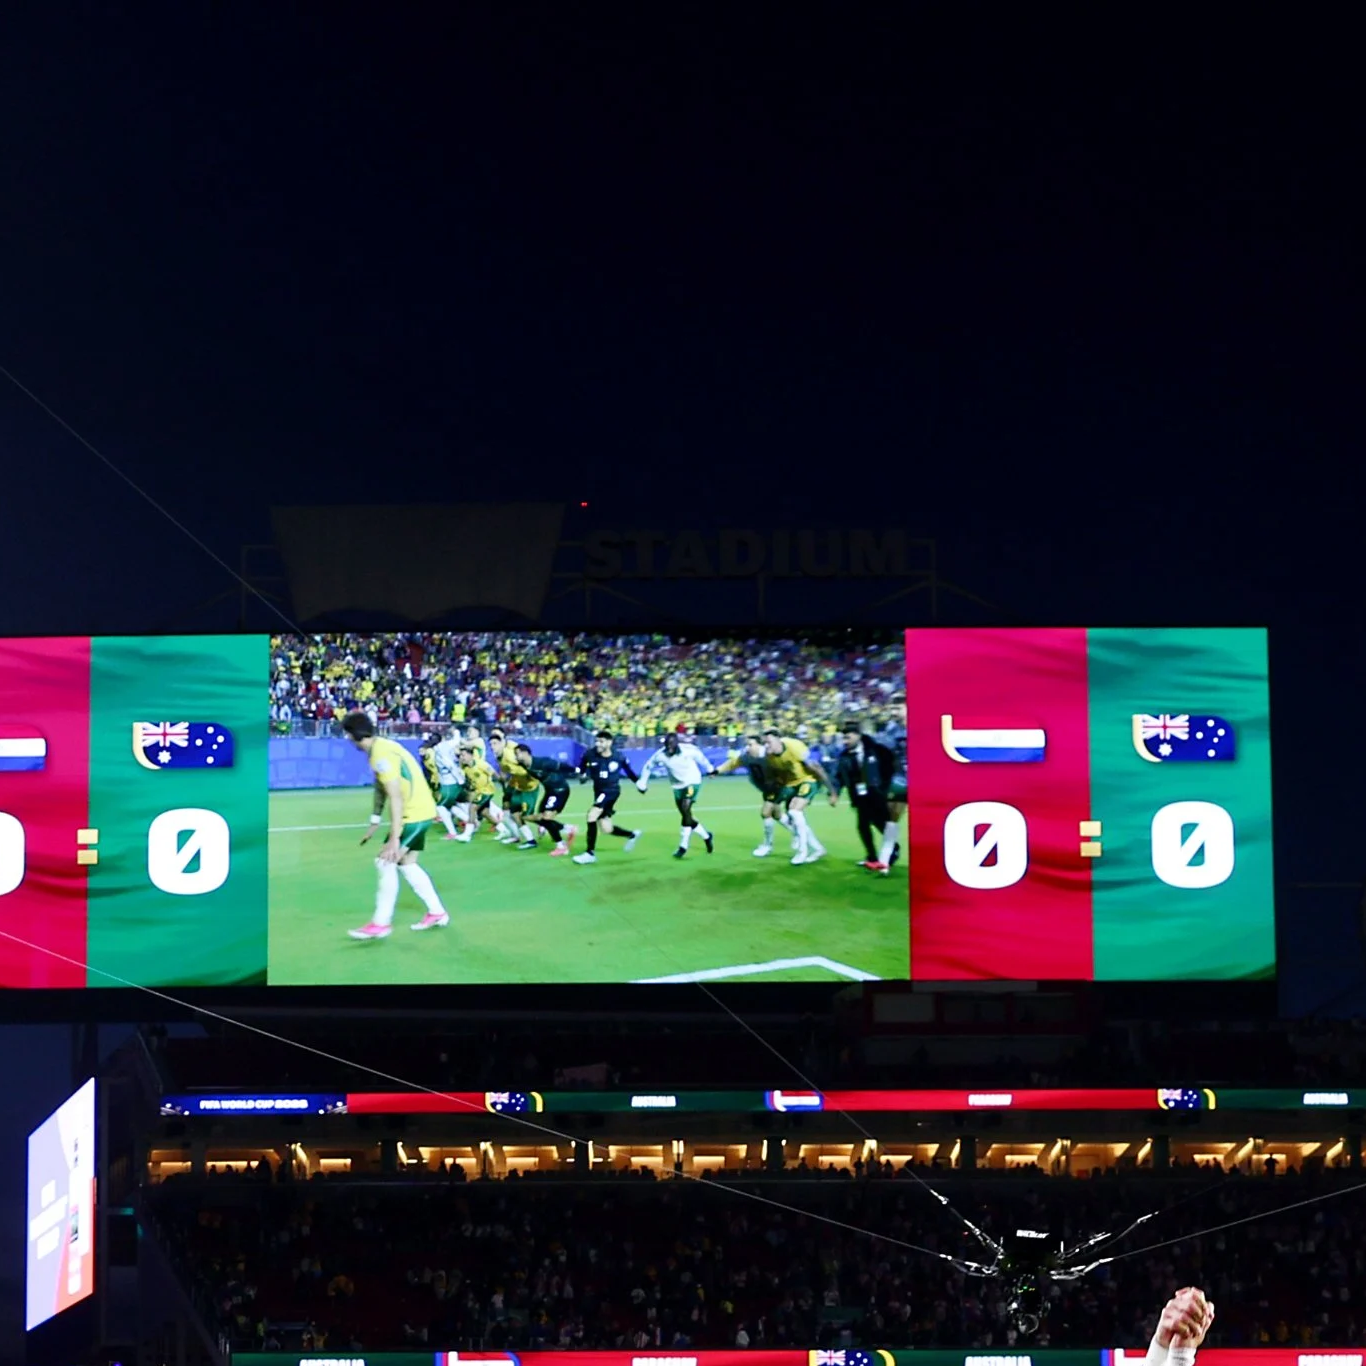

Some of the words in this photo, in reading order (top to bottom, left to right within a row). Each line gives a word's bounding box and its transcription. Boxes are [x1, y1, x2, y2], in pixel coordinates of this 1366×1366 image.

[585, 528, 909, 579] STADIUM
[148, 808, 230, 895] 0
[943, 801, 1028, 889] 0
[1151, 801, 1235, 888] 0
[200, 1100, 220, 1109] FIFA
[221, 1100, 254, 1109] WORLD
[255, 1100, 274, 1108] CUP
